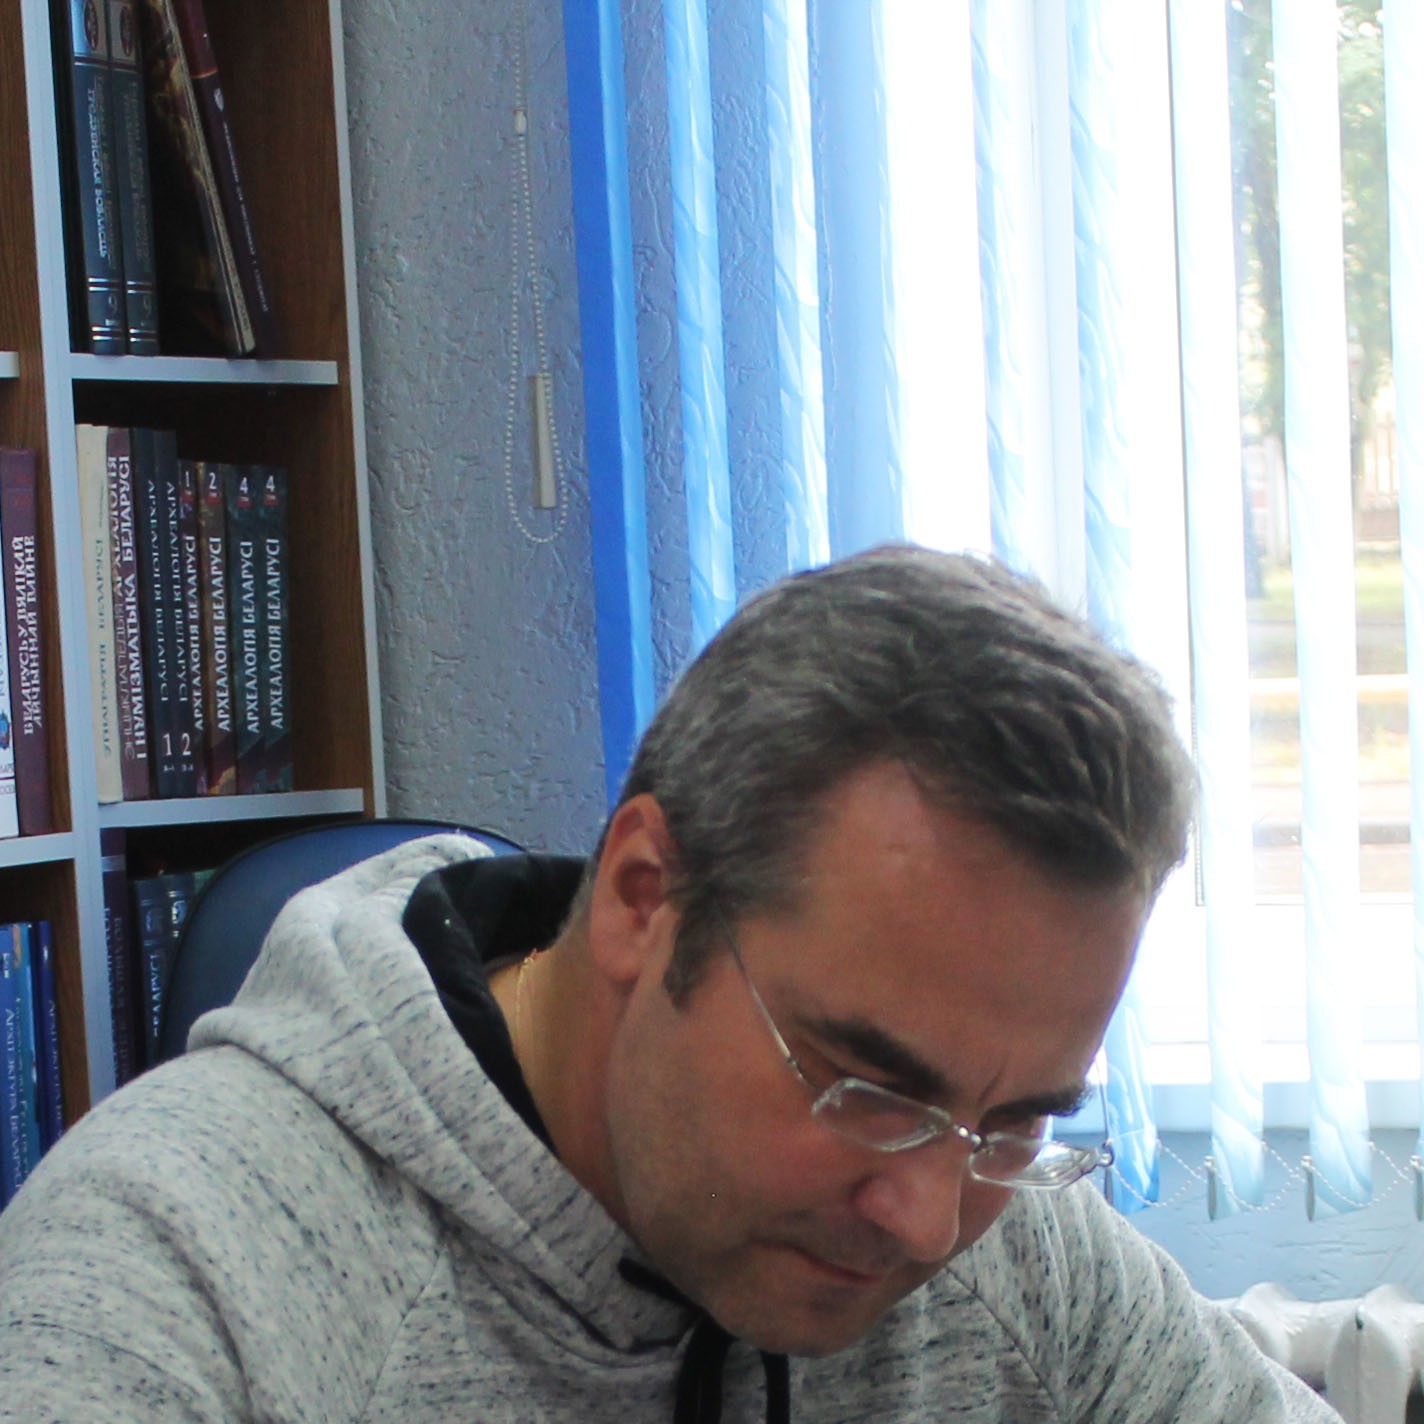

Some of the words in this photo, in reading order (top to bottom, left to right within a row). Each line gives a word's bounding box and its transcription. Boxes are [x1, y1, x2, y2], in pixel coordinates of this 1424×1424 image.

[118, 456, 133, 560] БЕЛАРУСІ
[185, 471, 190, 487] 1
[209, 472, 216, 490] 2
[240, 477, 248, 493] 4
[266, 475, 275, 492] 4
[108, 456, 123, 597] АРХЕАЛОГІЯ
[12, 535, 27, 620] ВЯЛІКАЙ
[94, 539, 106, 629] БЕЛАРУСІ
[184, 535, 197, 619] БЕЛАРУСІ
[209, 537, 225, 620] БЕЛАРУСІ
[239, 541, 255, 623] БЕЛАРУСІ
[265, 539, 281, 621] БЕЛАРУСІ
[19, 640, 35, 735] БЕЛАРУСЬ
[115, 603, 135, 759] ЭНЦЫКЛАПЕДЫЯ
[124, 574, 146, 745] НУМІЗМАТЫКА
[187, 625, 203, 731] АРХЕАЛОГІЯ
[212, 626, 231, 732] АРХЕАЛОГІЯ
[242, 629, 260, 733] АРХЕАЛОГІЯ
[267, 626, 284, 729] АРХЕАЛОГІЯ
[163, 732, 172, 756] 1
[182, 732, 191, 756] 2
